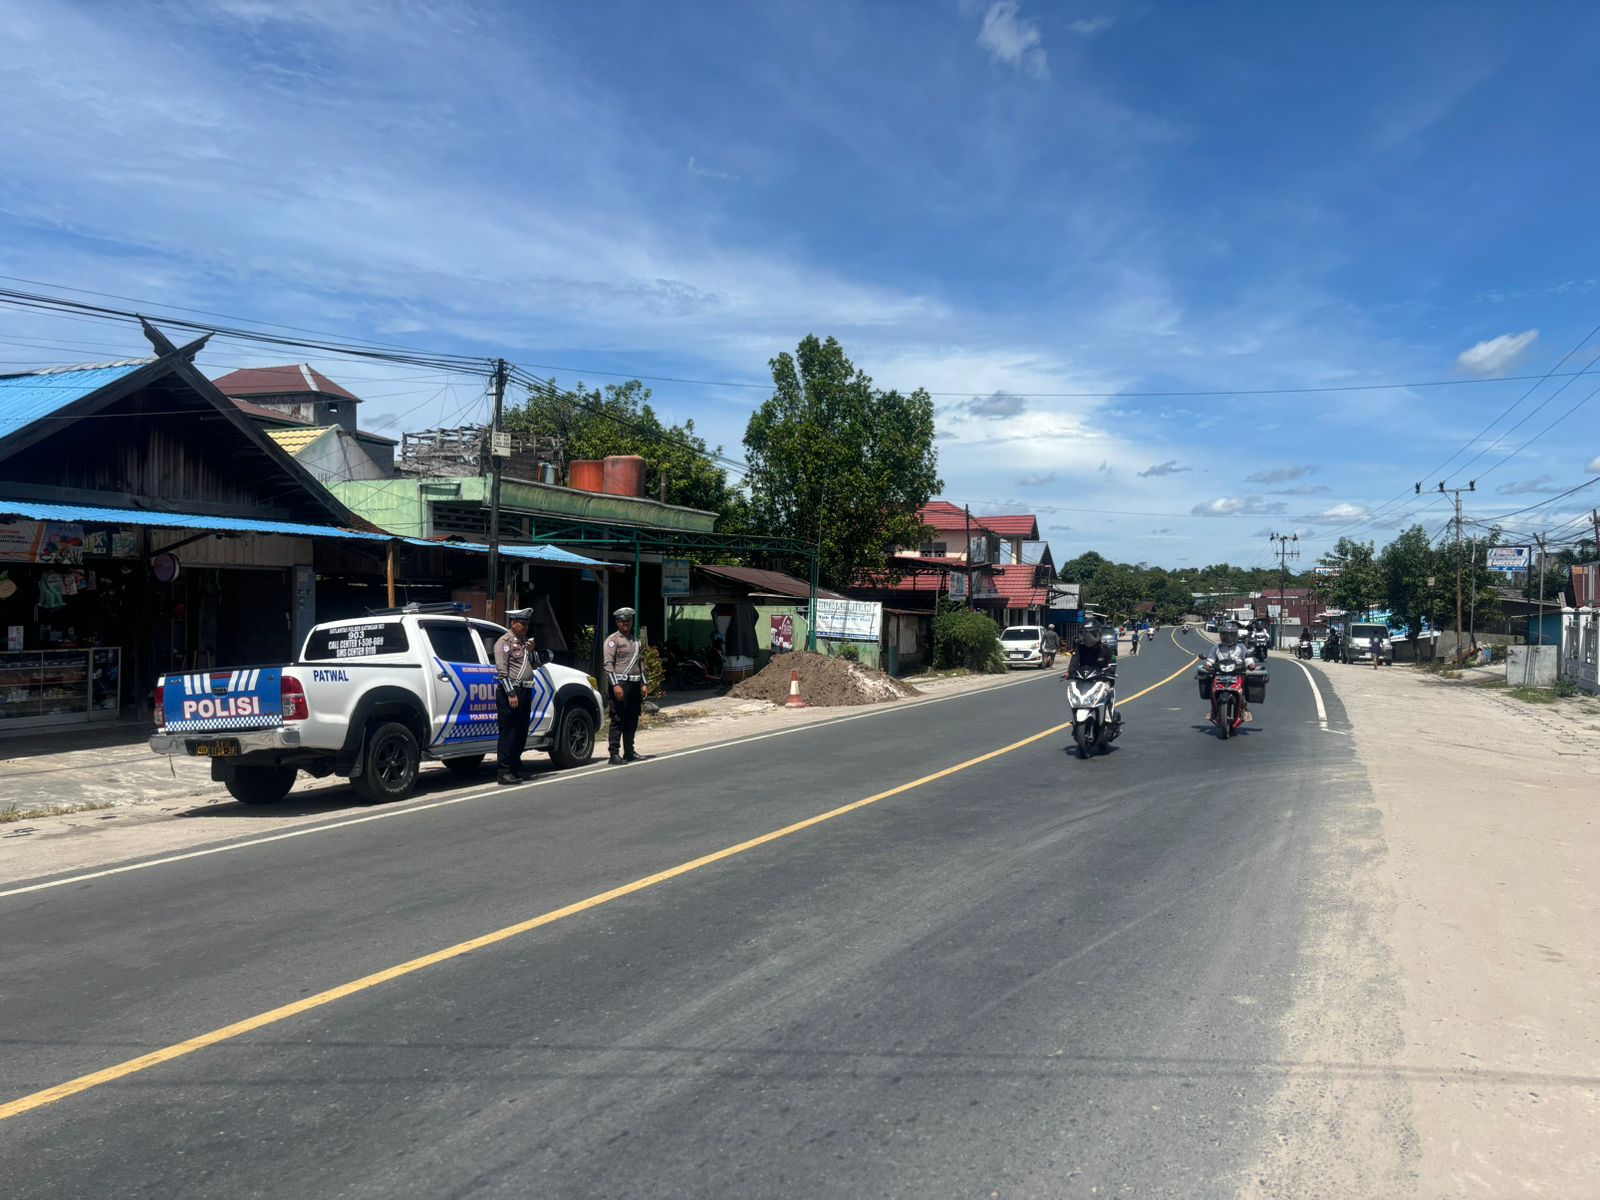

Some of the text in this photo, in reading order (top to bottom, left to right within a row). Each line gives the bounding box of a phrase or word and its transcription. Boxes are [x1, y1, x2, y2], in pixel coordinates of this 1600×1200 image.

[348, 631, 365, 640] 903
[328, 640, 340, 650] CALL
[340, 638, 358, 649] CENTER
[347, 647, 365, 657] CENTER
[314, 670, 349, 682] PATWAL
[470, 684, 498, 700] POLI
[184, 696, 260, 720] POLISI
[470, 704, 486, 712] LALU
[470, 713, 488, 721] POLRES
